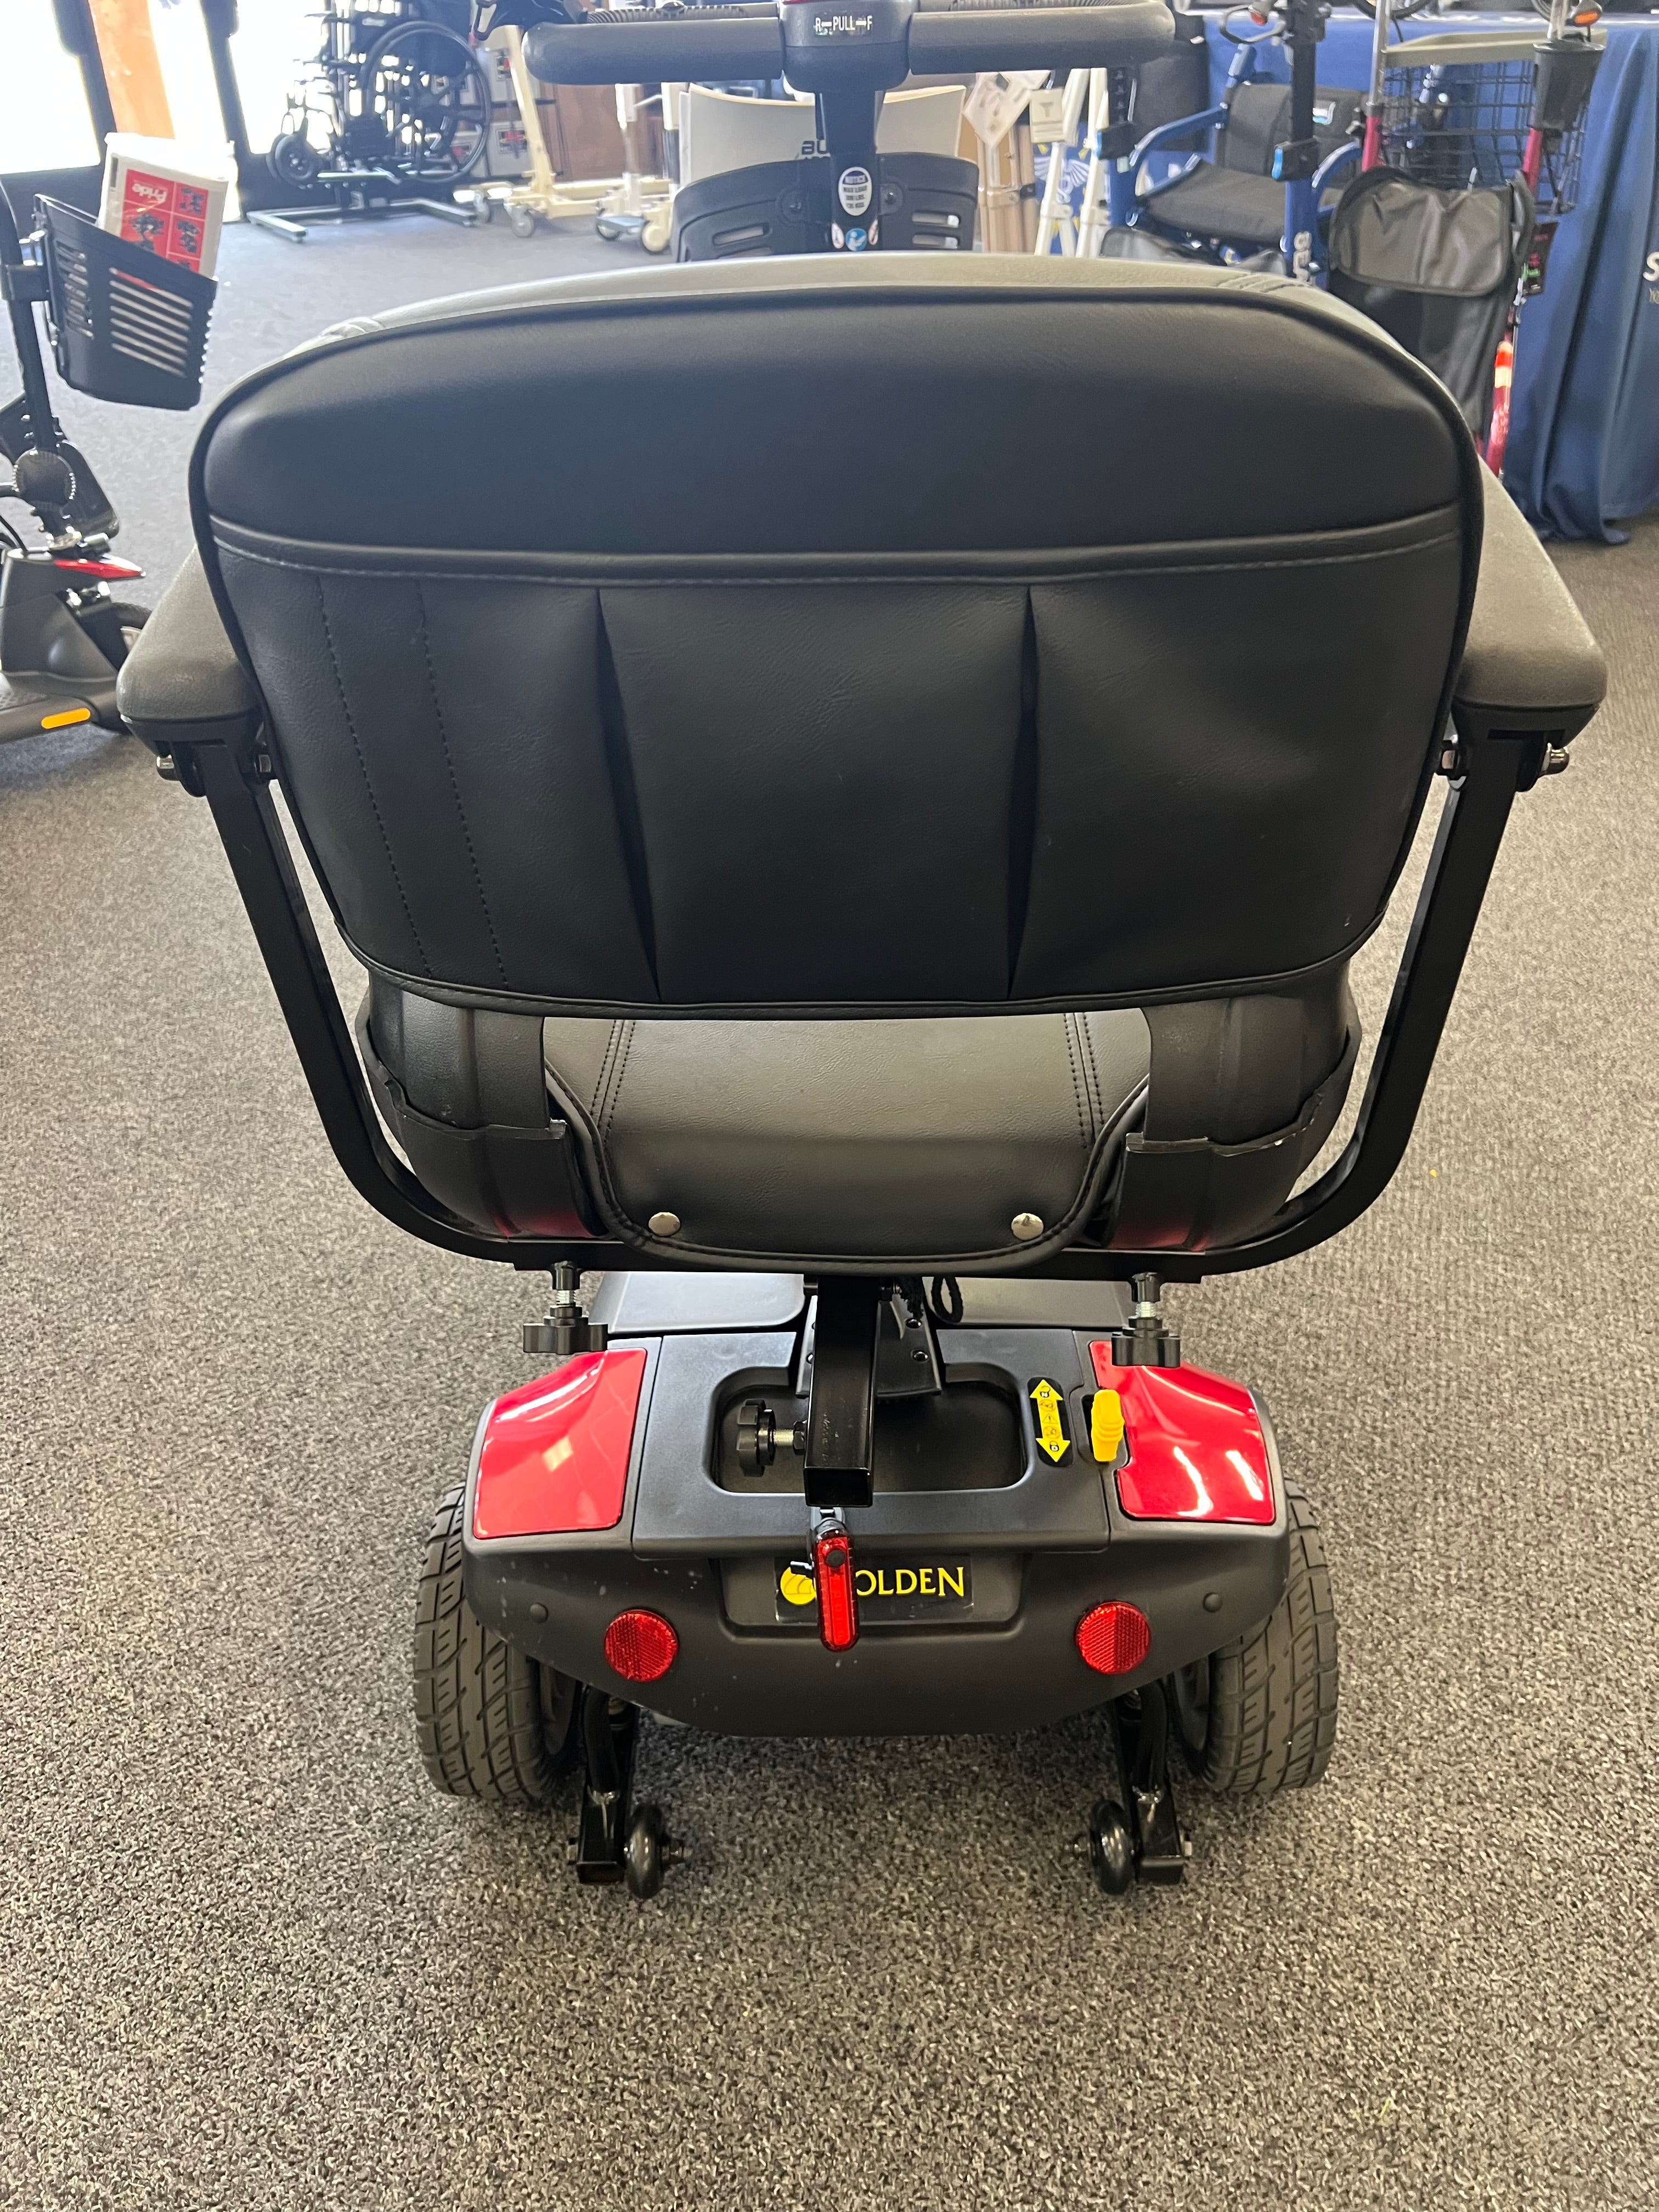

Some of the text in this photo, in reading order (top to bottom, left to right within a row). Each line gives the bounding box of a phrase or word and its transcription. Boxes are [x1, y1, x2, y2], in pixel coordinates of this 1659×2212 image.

[815, 15, 872, 32] R PULL F
[132, 183, 167, 202] Pride
[855, 1567, 964, 1597] OLDEN
